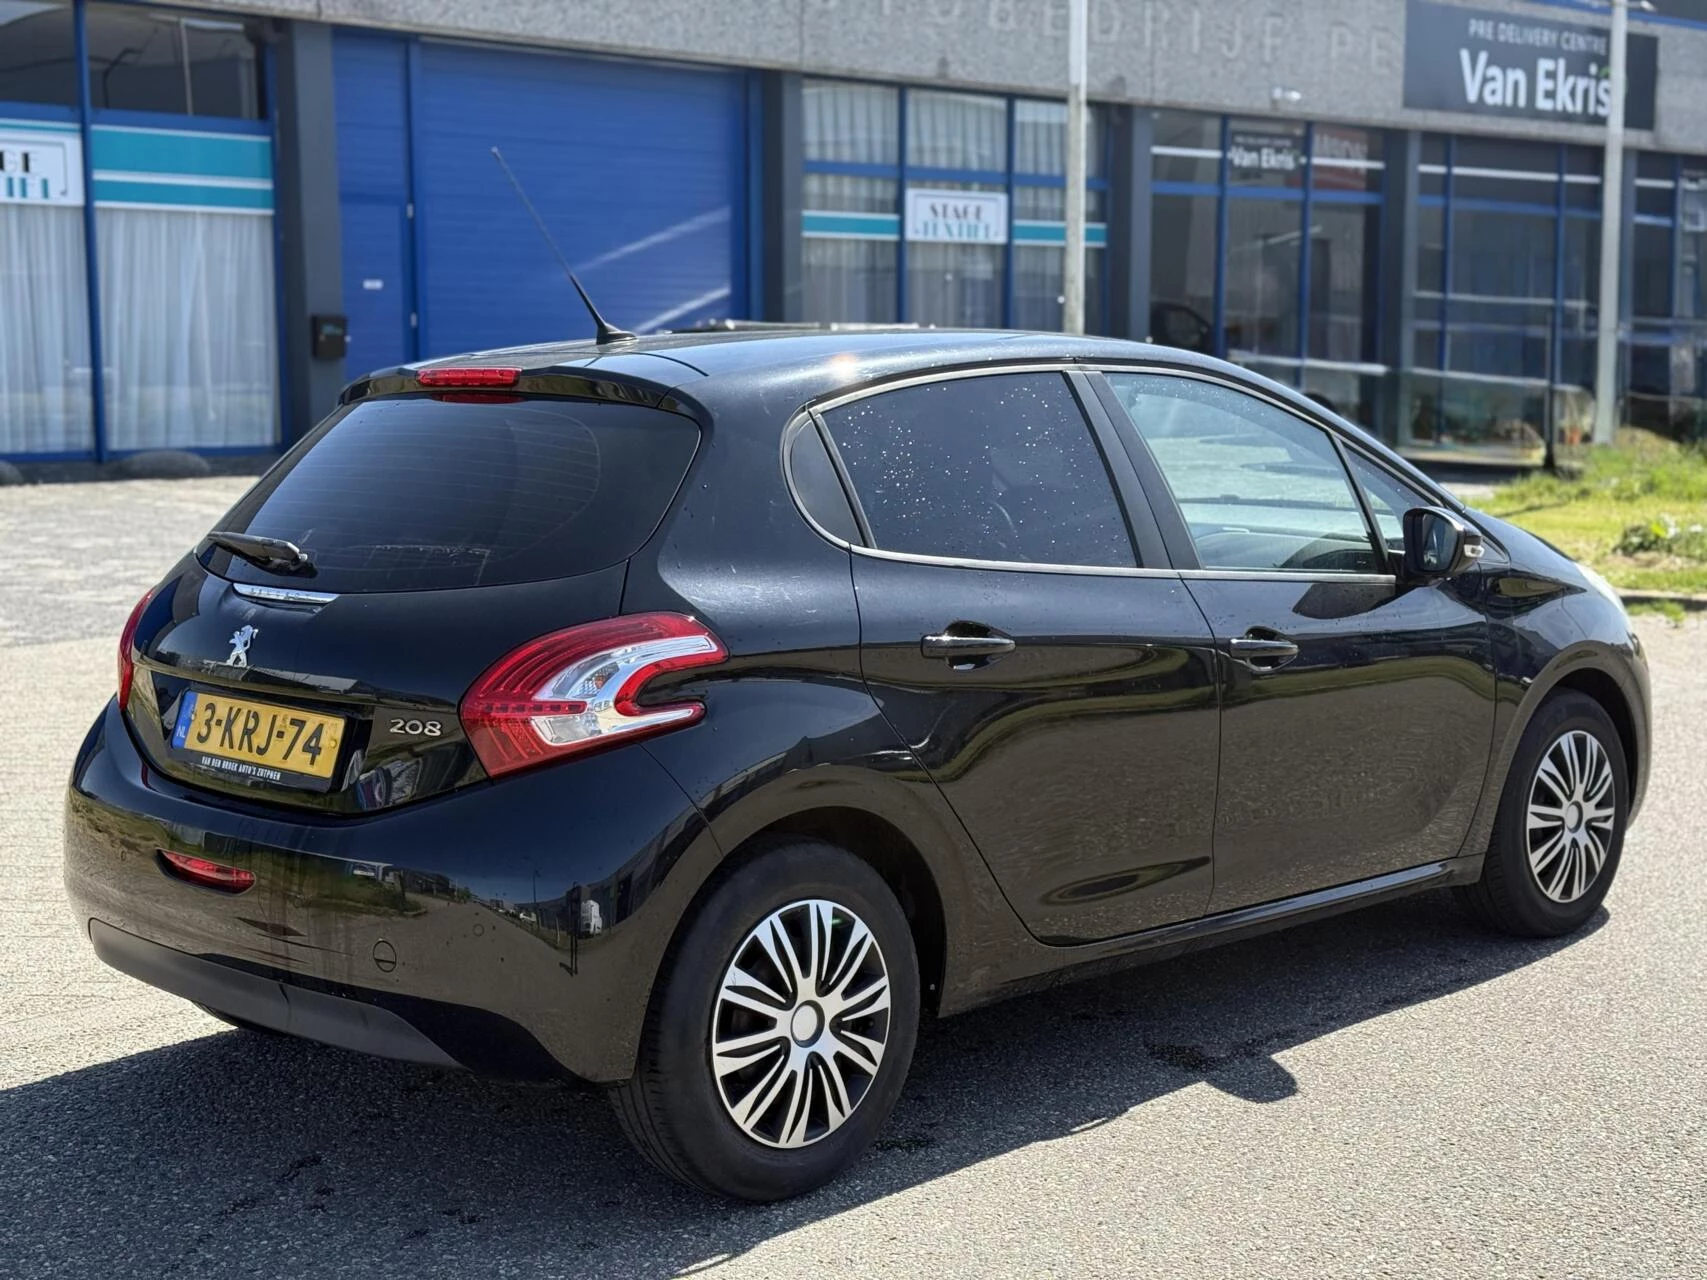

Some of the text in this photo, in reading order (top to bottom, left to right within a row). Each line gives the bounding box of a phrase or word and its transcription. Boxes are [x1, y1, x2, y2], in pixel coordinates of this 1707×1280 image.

[1468, 18, 1608, 56] PRE DELIVERY CENTRE
[1459, 48, 1611, 118] Van Ekris
[176, 725, 187, 738] NL
[196, 702, 325, 766] 3-KRJ-74
[390, 718, 442, 737] 208
[202, 755, 211, 765] VAN
[211, 758, 221, 768] DEN
[239, 763, 256, 775] AUTO'S
[256, 767, 282, 781] ZUTPHEN
